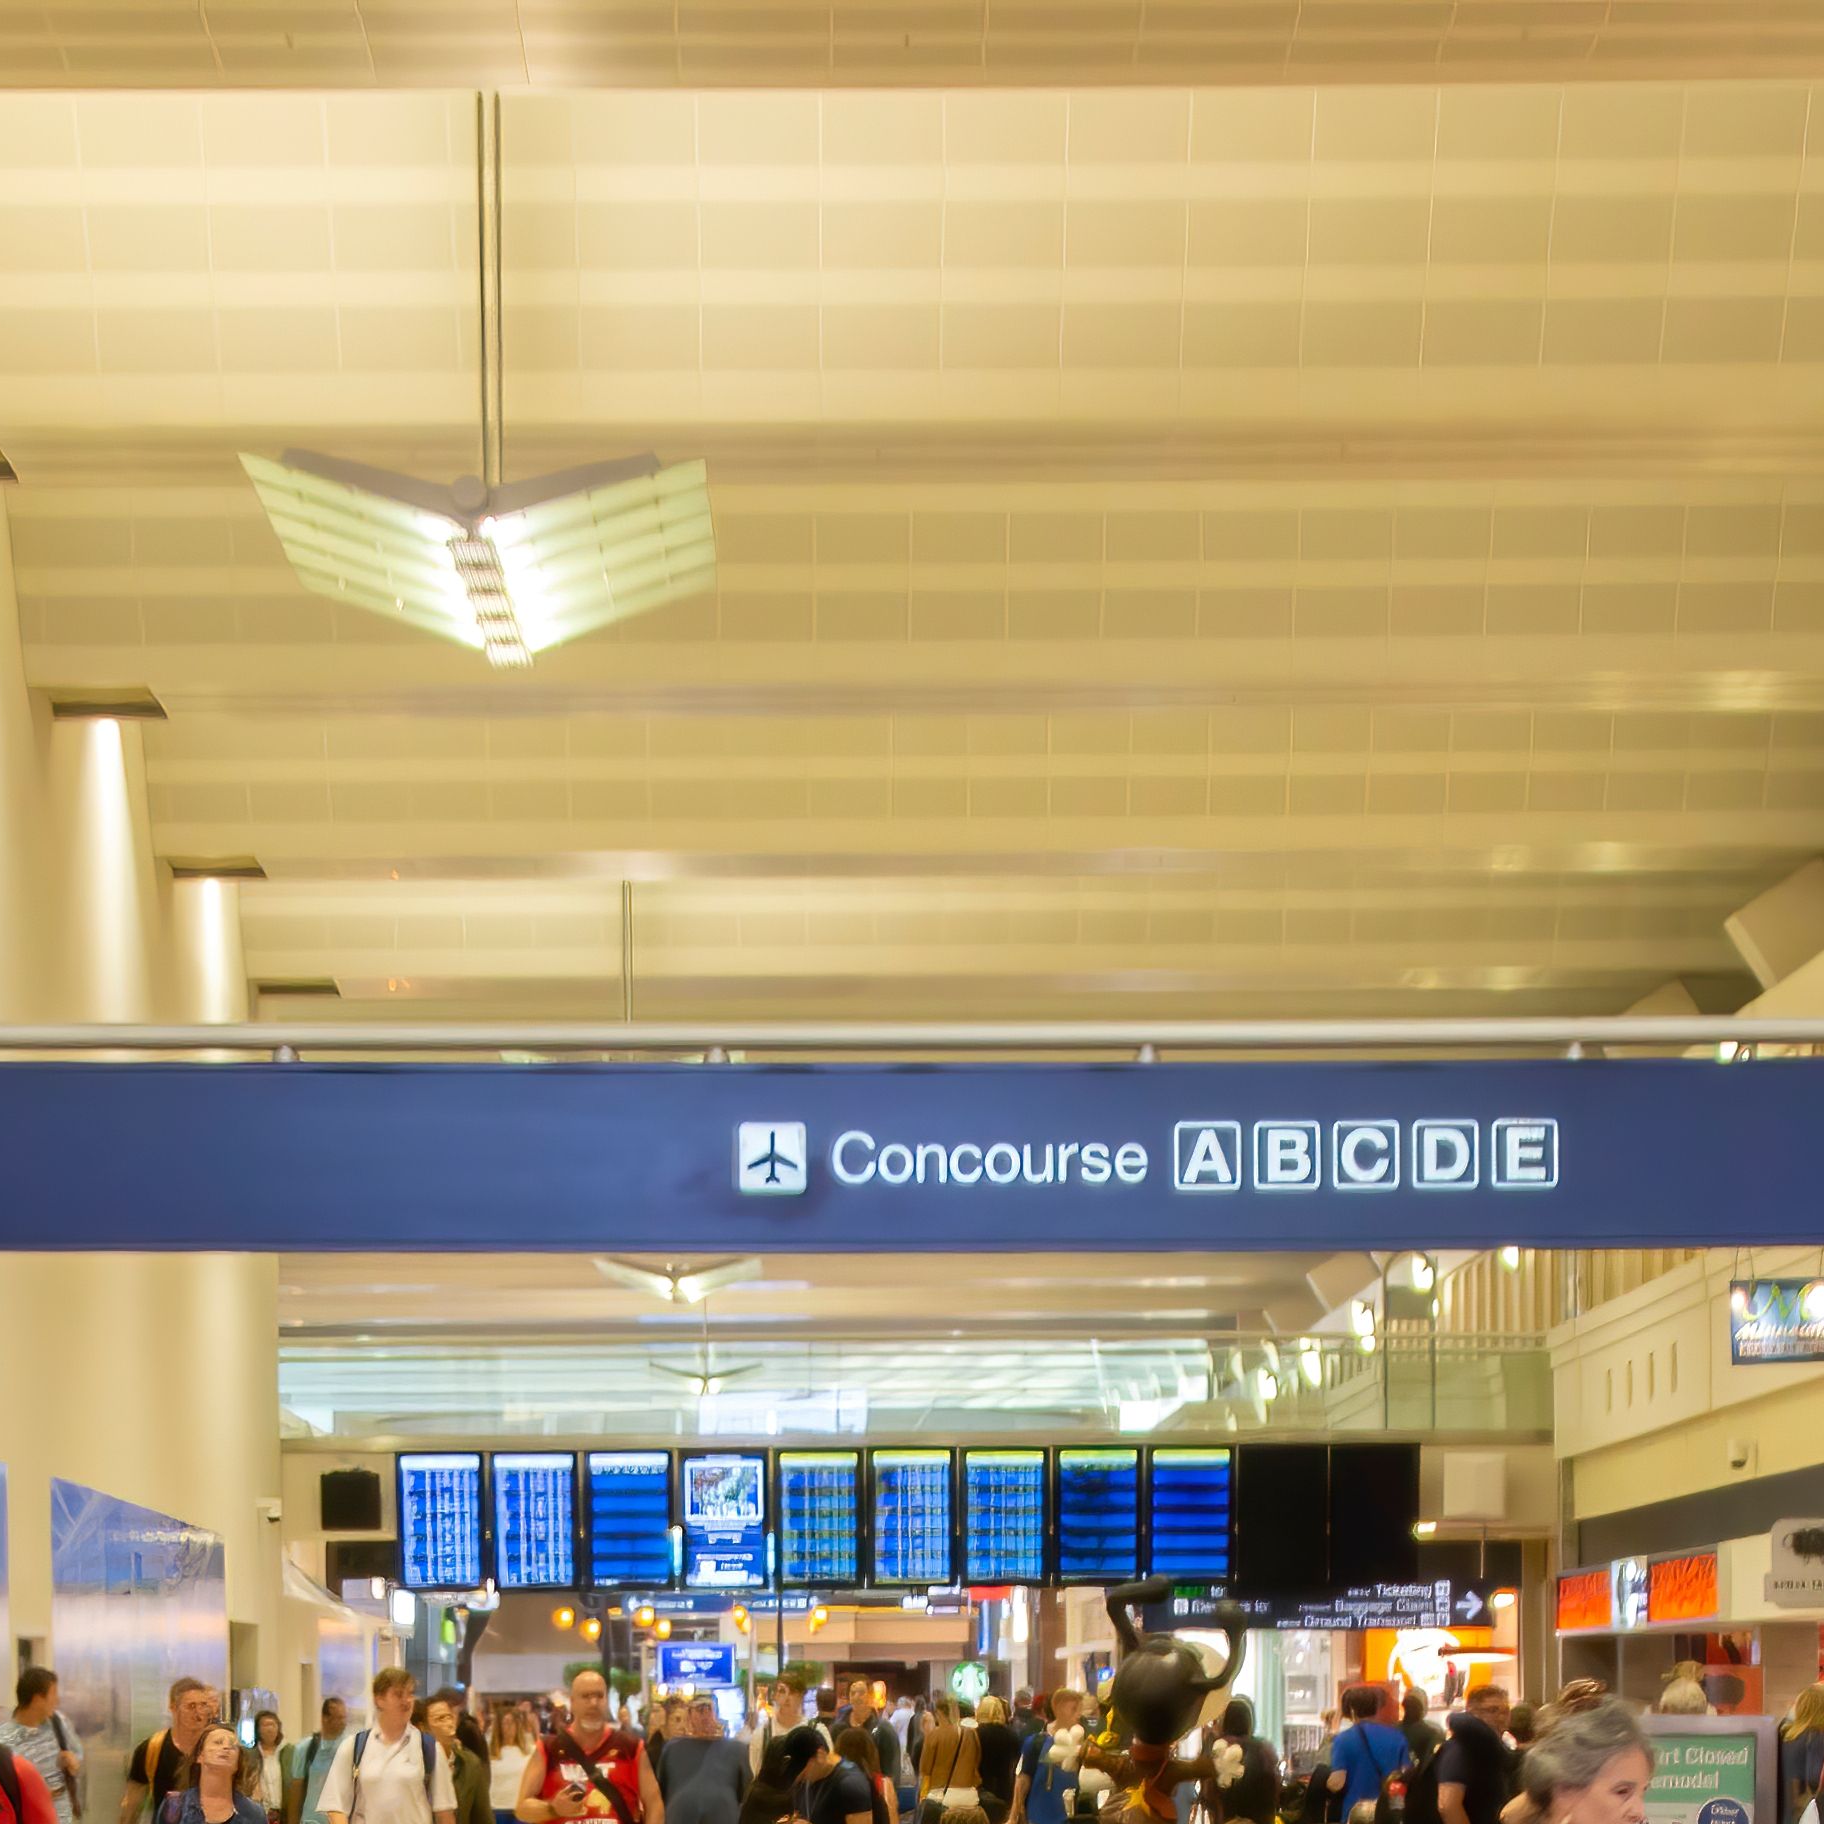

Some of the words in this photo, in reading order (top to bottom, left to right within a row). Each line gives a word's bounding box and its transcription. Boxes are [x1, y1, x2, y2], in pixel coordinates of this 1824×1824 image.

[831, 1130, 1149, 1185] Concourse
[1183, 1129, 1232, 1184] A
[1266, 1129, 1312, 1183] B
[1340, 1128, 1390, 1182] C
[1423, 1128, 1470, 1180] D
[1506, 1127, 1548, 1180] E
